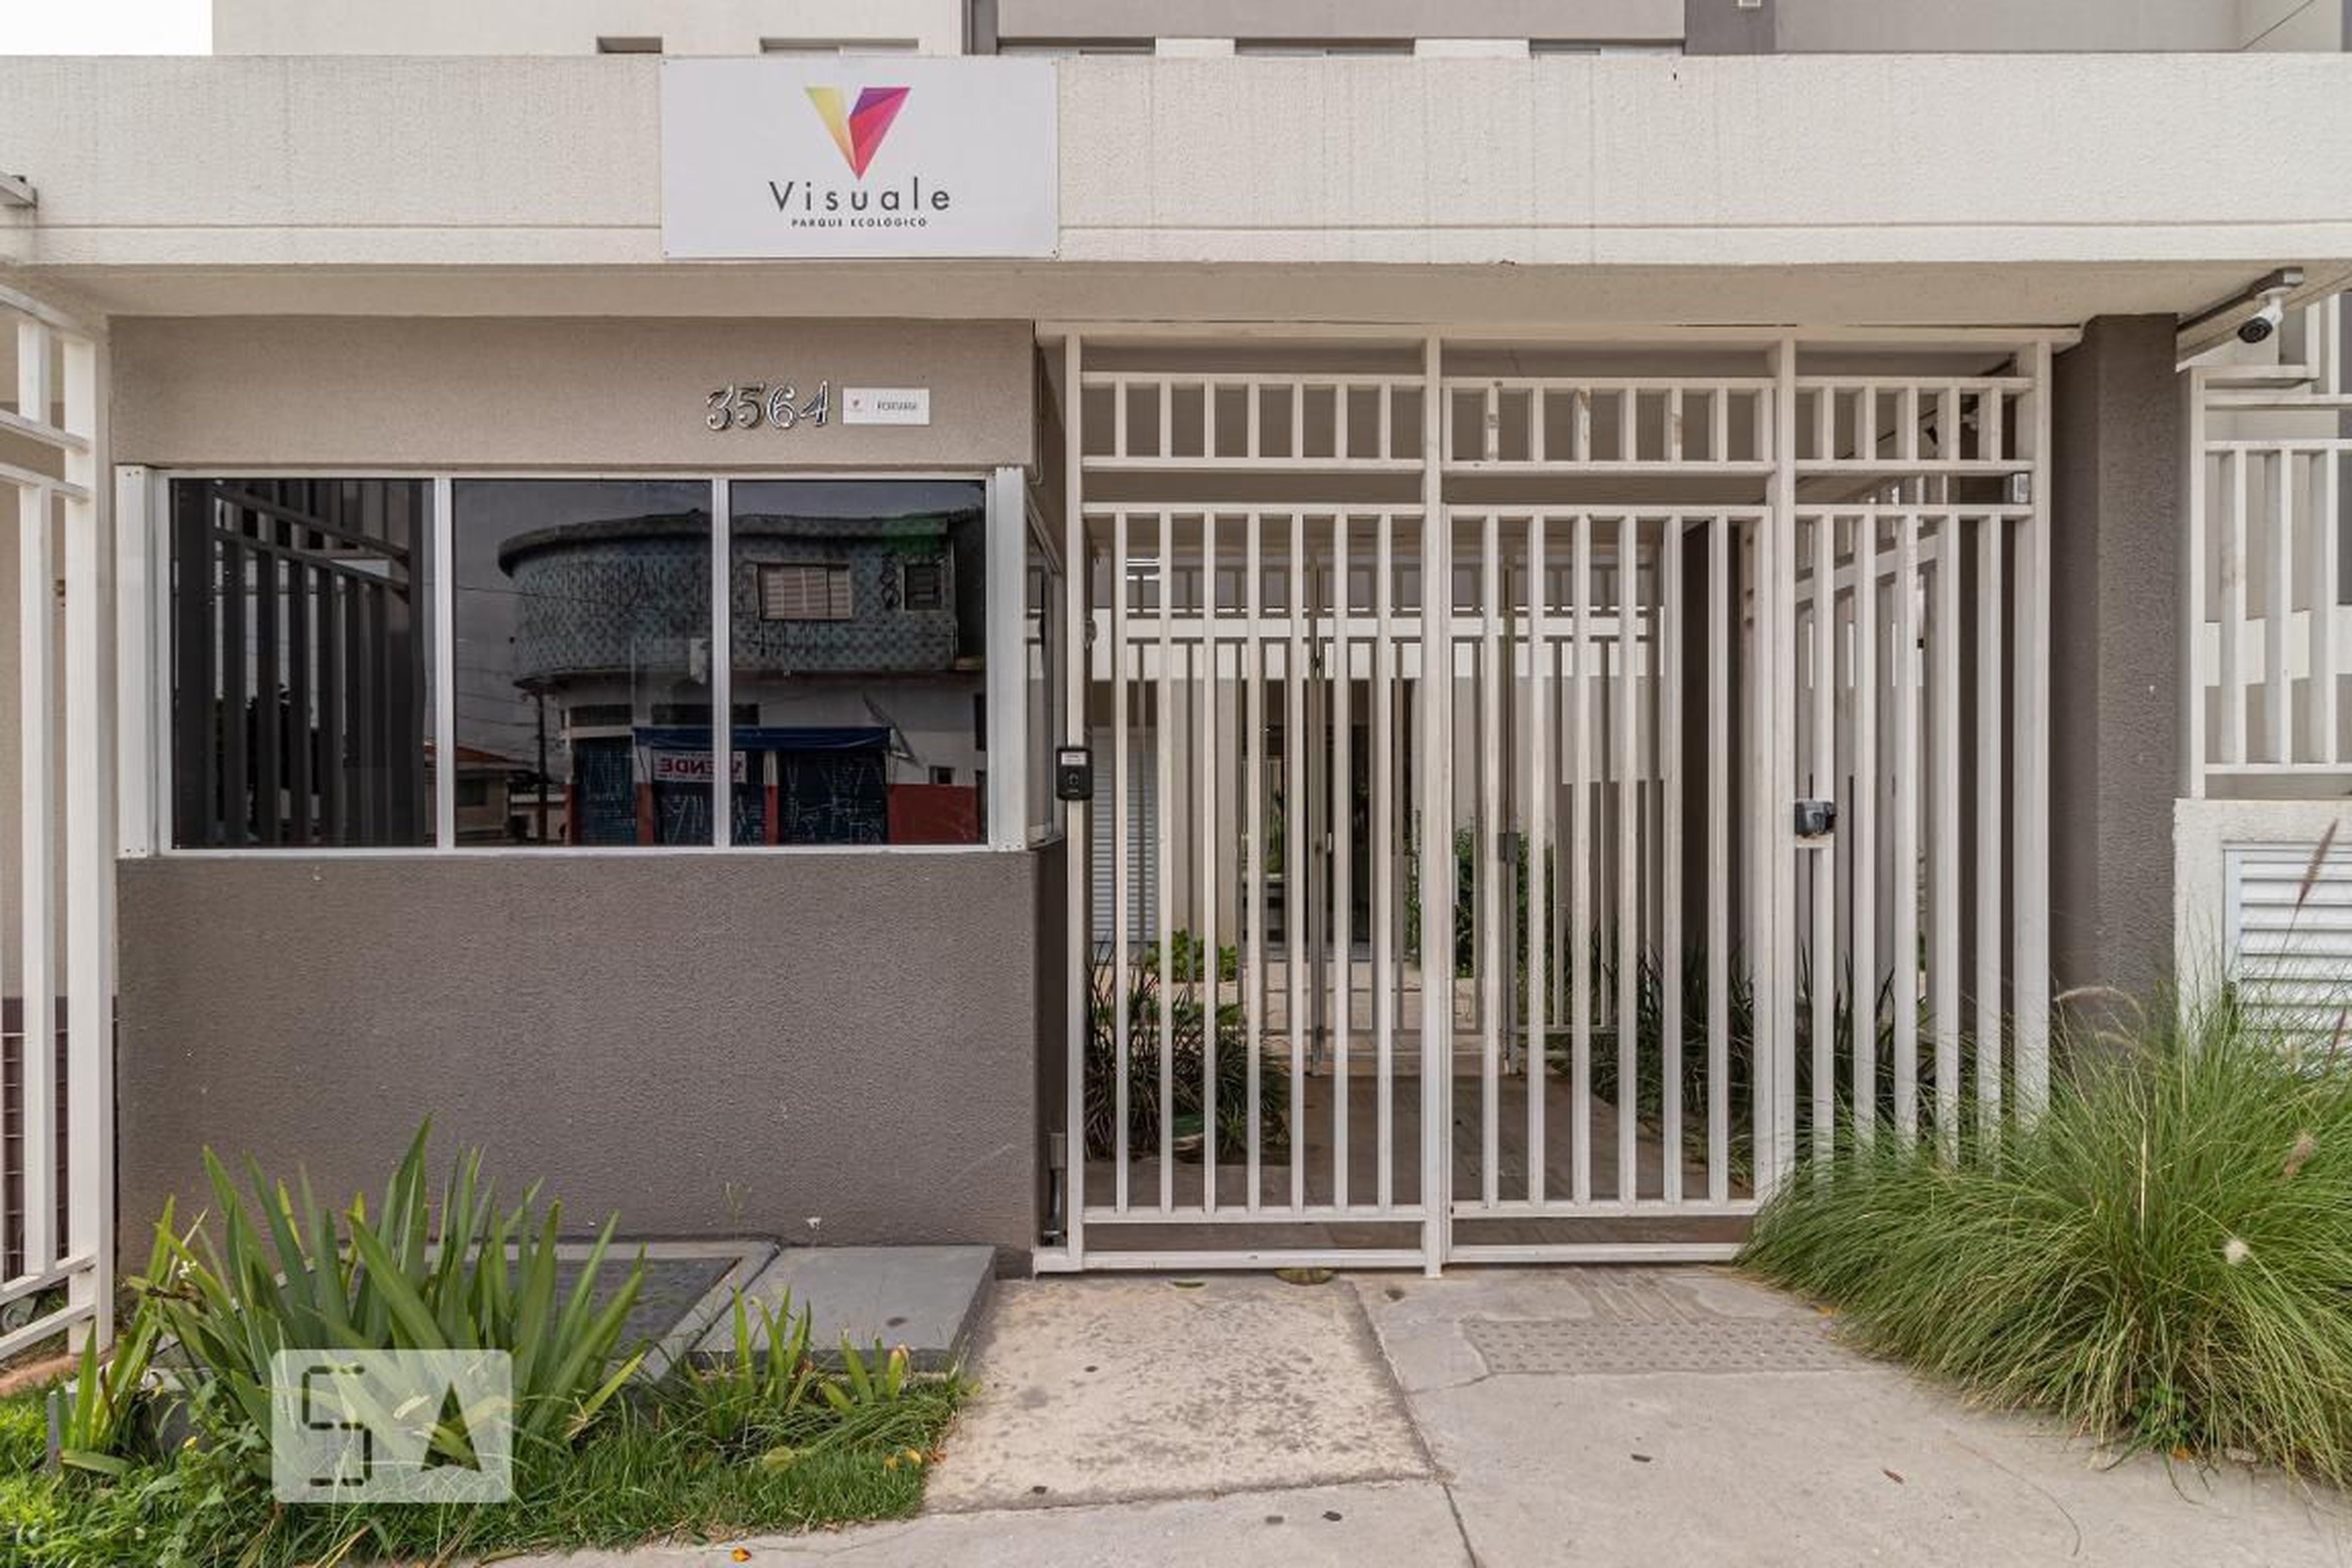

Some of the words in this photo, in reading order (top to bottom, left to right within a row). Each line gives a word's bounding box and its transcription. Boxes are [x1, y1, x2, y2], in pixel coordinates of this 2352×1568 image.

[769, 176, 950, 211] Visuale
[791, 217, 843, 227] PARQUE
[706, 381, 829, 430] 3564
